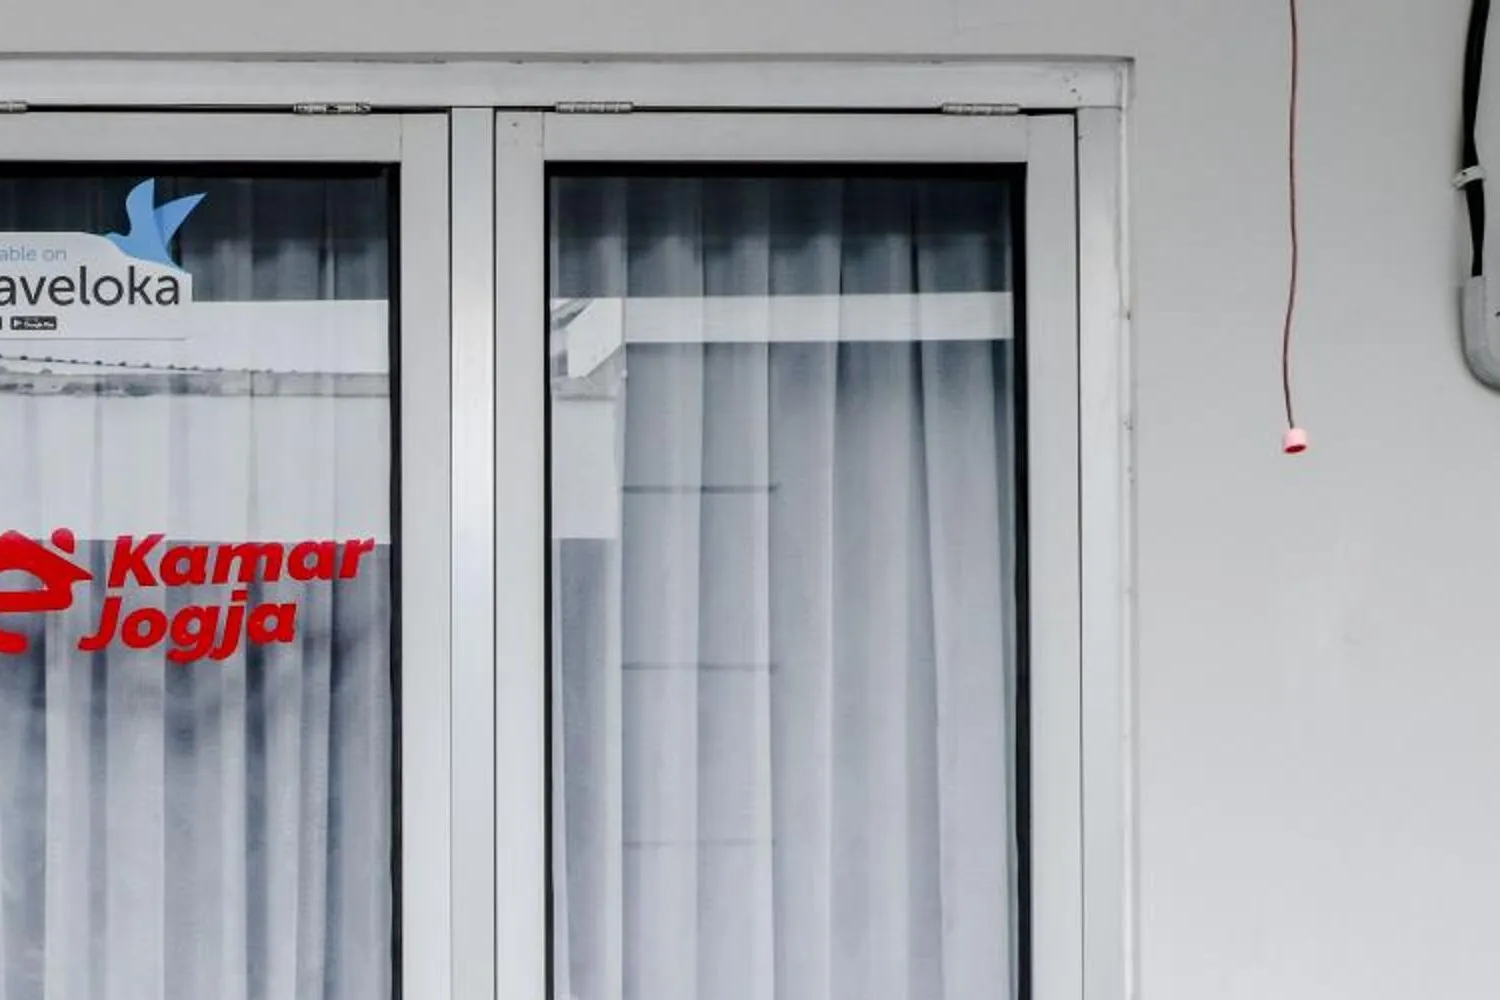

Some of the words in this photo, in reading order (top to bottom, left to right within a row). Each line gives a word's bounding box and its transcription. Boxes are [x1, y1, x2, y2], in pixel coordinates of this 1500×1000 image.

[42, 249, 68, 262] on
[107, 534, 376, 588] Kamar
[77, 590, 297, 664] Jogja
